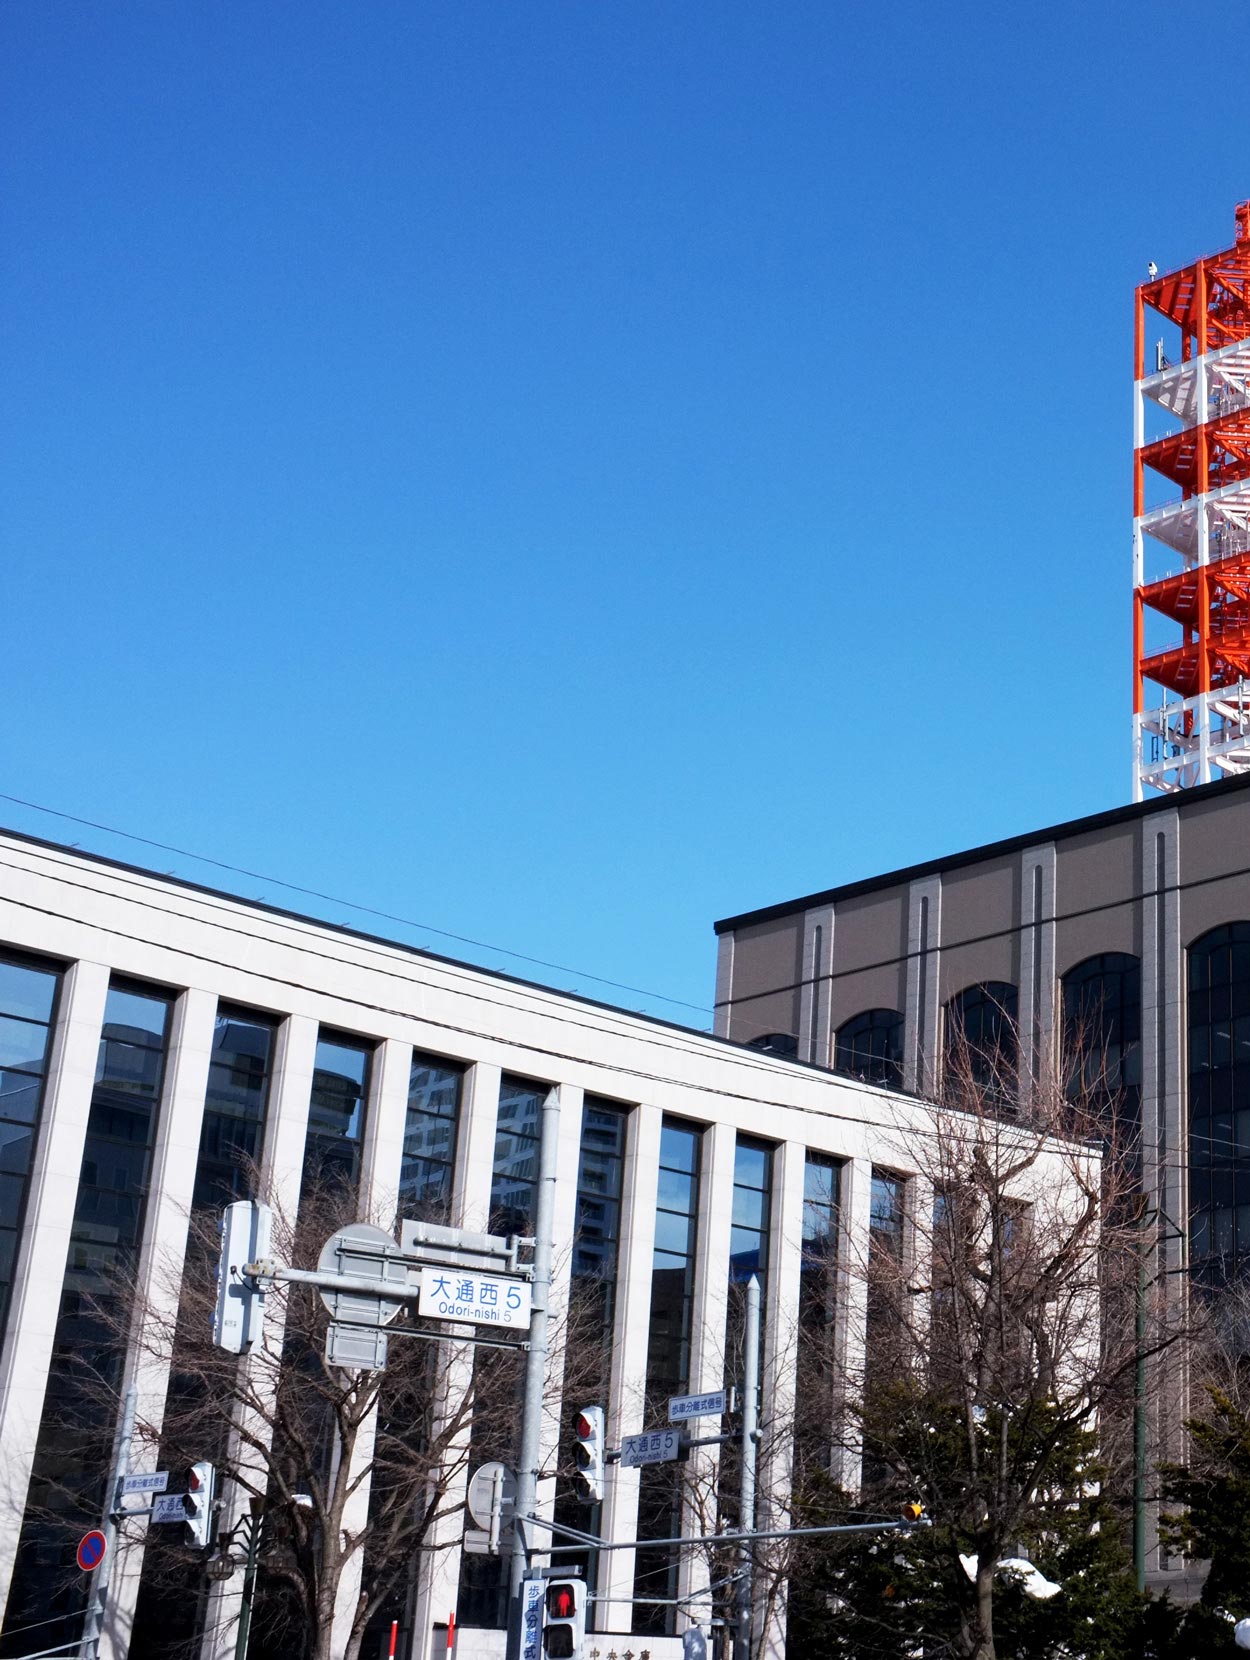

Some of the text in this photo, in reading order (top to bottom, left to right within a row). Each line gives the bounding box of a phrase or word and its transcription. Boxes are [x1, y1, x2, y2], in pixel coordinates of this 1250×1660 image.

[430, 1275, 521, 1309] 大通西5
[438, 1301, 512, 1323] Odori-nishi 5
[625, 1432, 673, 1455] 大通西5
[156, 1497, 183, 1512] 大通西
[523, 1585, 540, 1659] 歩車分離式
